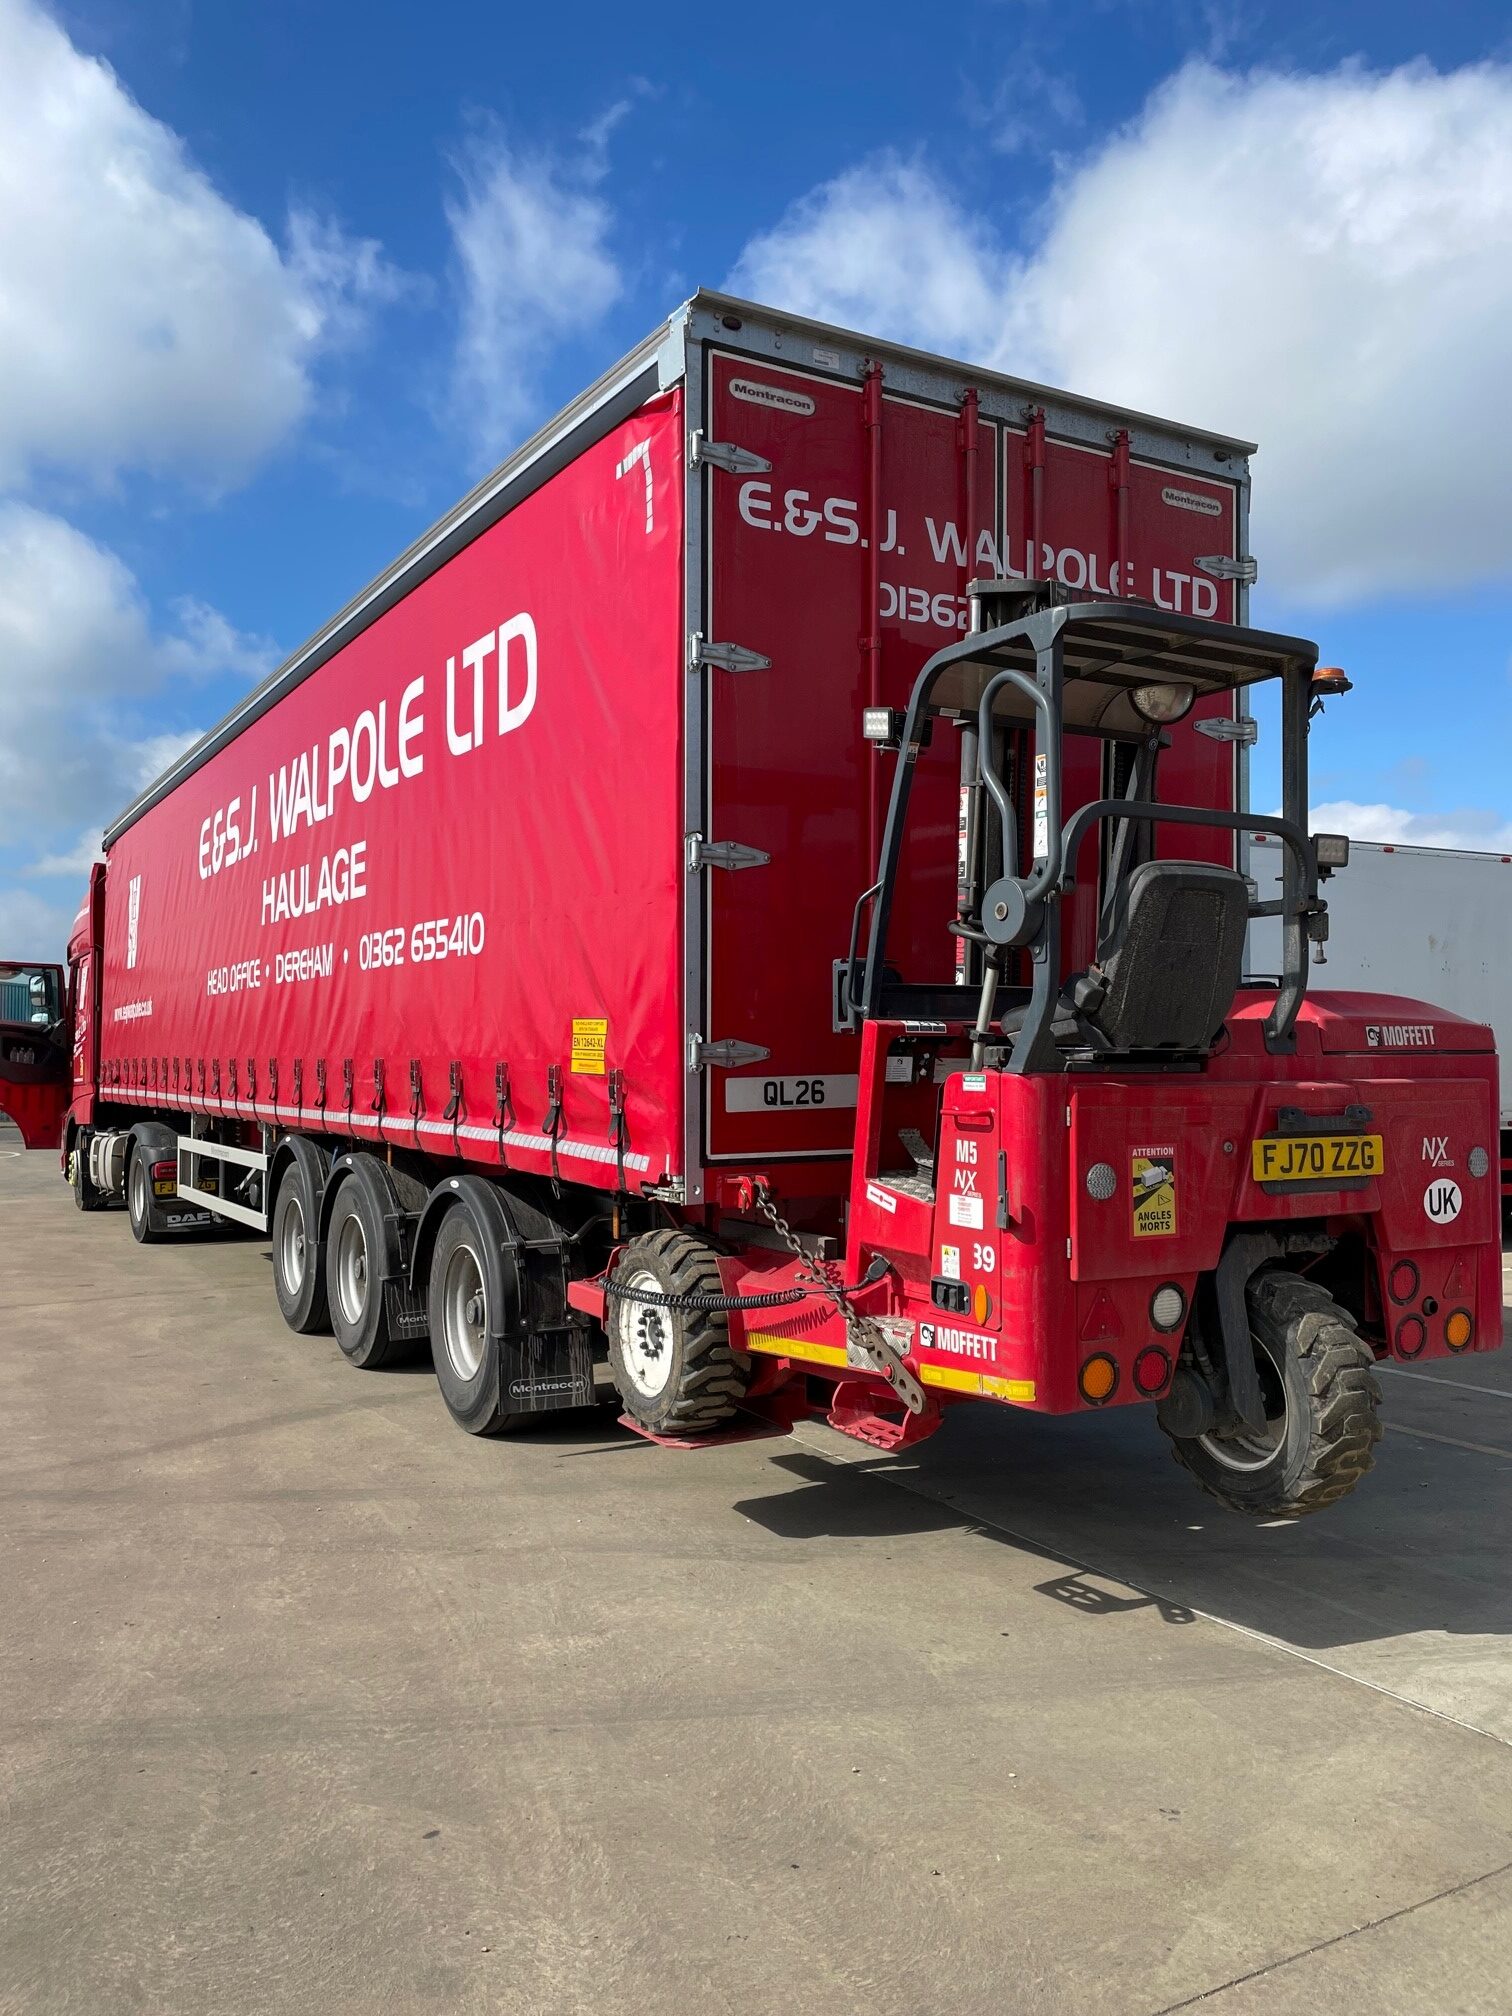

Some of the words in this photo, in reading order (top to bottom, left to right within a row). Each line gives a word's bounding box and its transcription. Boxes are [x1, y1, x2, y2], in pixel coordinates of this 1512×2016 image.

[734, 383, 811, 410] Montracon
[1164, 490, 1220, 512] Montracon
[924, 516, 1137, 598] WALPOLE
[1152, 567, 1218, 618] LTD
[269, 674, 424, 843] WALPOLE
[446, 612, 538, 756] LTD
[261, 841, 367, 926] HAULAGE
[207, 966, 228, 996] HEAD
[229, 958, 261, 993] OFFICE
[275, 943, 333, 984] DEREHAM
[359, 927, 405, 971] 01362
[411, 911, 485, 963] 655410
[574, 1037, 580, 1047] EN
[1382, 1025, 1435, 1046] MOFFETT
[764, 1080, 825, 1106] QL26
[955, 1139, 978, 1165] M5
[1132, 1147, 1174, 1157] ATTENTION
[1263, 1143, 1325, 1175] FJ70
[1331, 1141, 1374, 1171] ZZG
[1422, 1136, 1449, 1167] NX
[1438, 1159, 1455, 1167] SERIES
[954, 1168, 978, 1196] NX
[1428, 1186, 1457, 1216] UK
[167, 1212, 210, 1223] DAF
[1138, 1210, 1172, 1221] ANGLES
[1140, 1220, 1171, 1232] MORTS
[973, 1242, 996, 1273] 39
[937, 1326, 998, 1362] MOFFETT
[512, 1379, 585, 1394] Montracon
